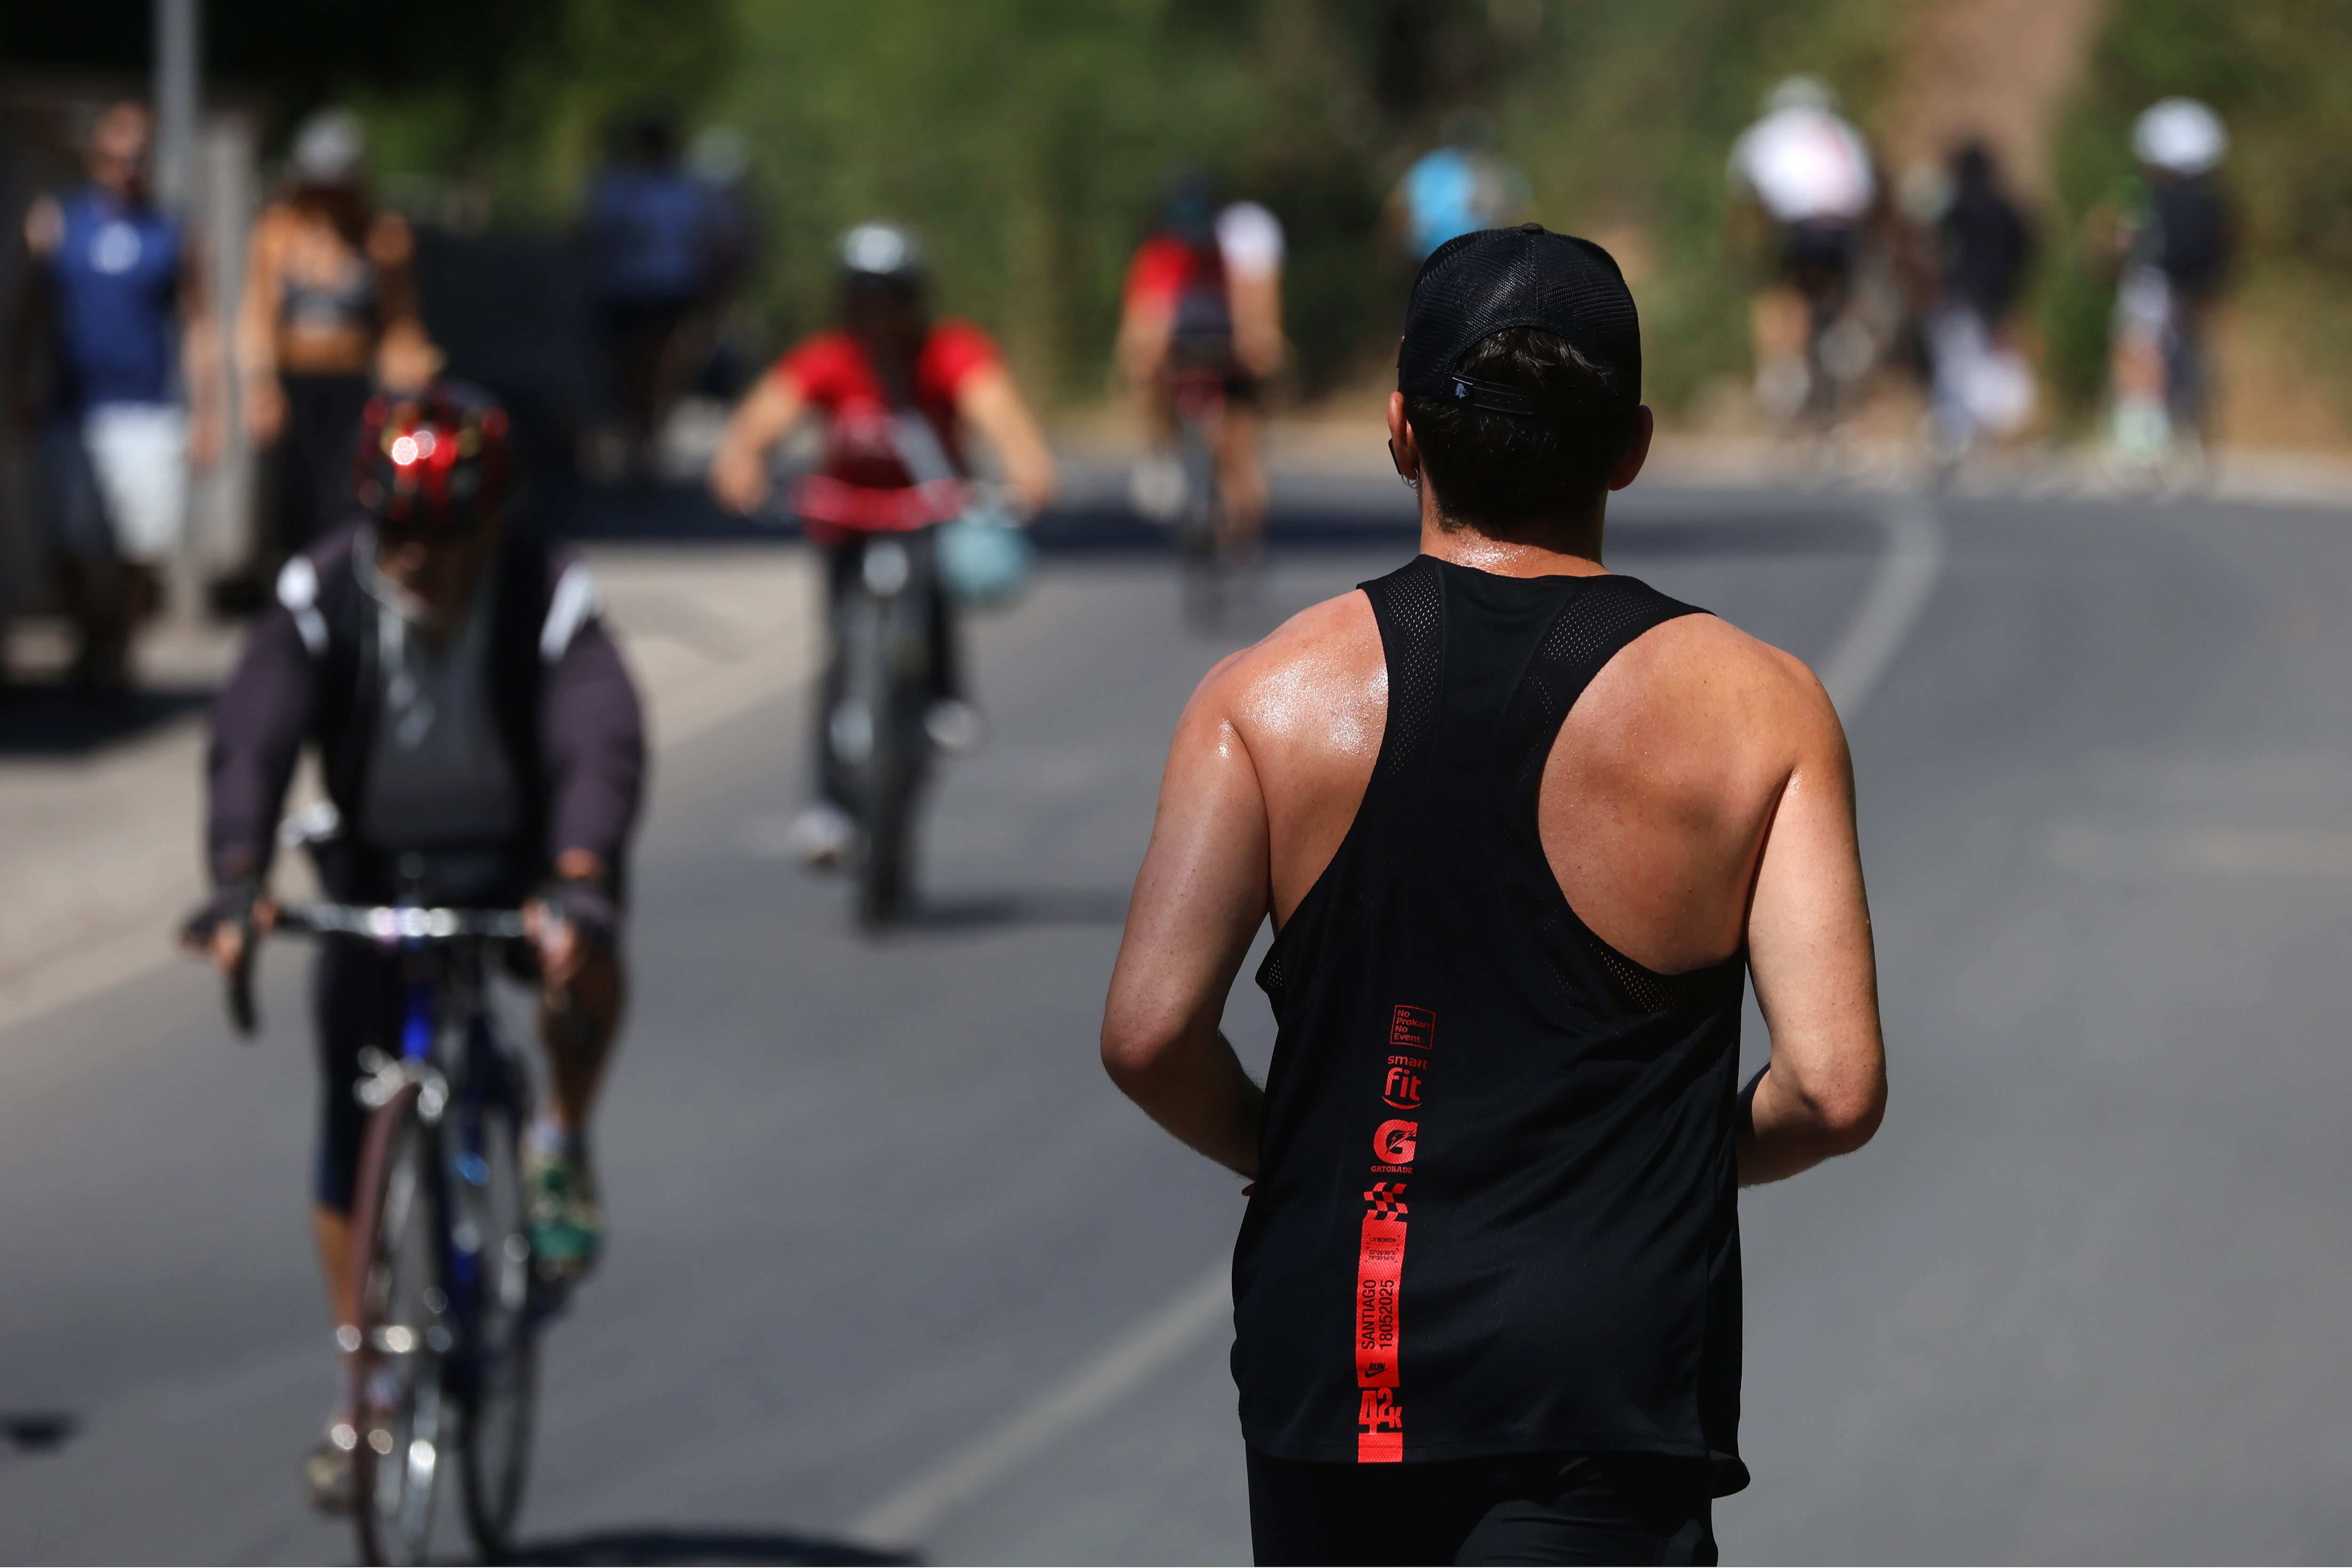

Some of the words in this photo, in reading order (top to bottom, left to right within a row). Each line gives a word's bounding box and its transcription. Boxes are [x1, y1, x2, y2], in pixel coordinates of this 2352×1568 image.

[1396, 1018, 1430, 1029] Prokart
[1394, 1033, 1421, 1043] Event
[1388, 1056, 1428, 1070] smart
[1385, 1067, 1422, 1101] fit
[1374, 1119, 1418, 1164] G
[1361, 1280, 1376, 1350] SANTIAGO
[1379, 1280, 1394, 1350] 18052025
[1368, 1362, 1386, 1371] RUN
